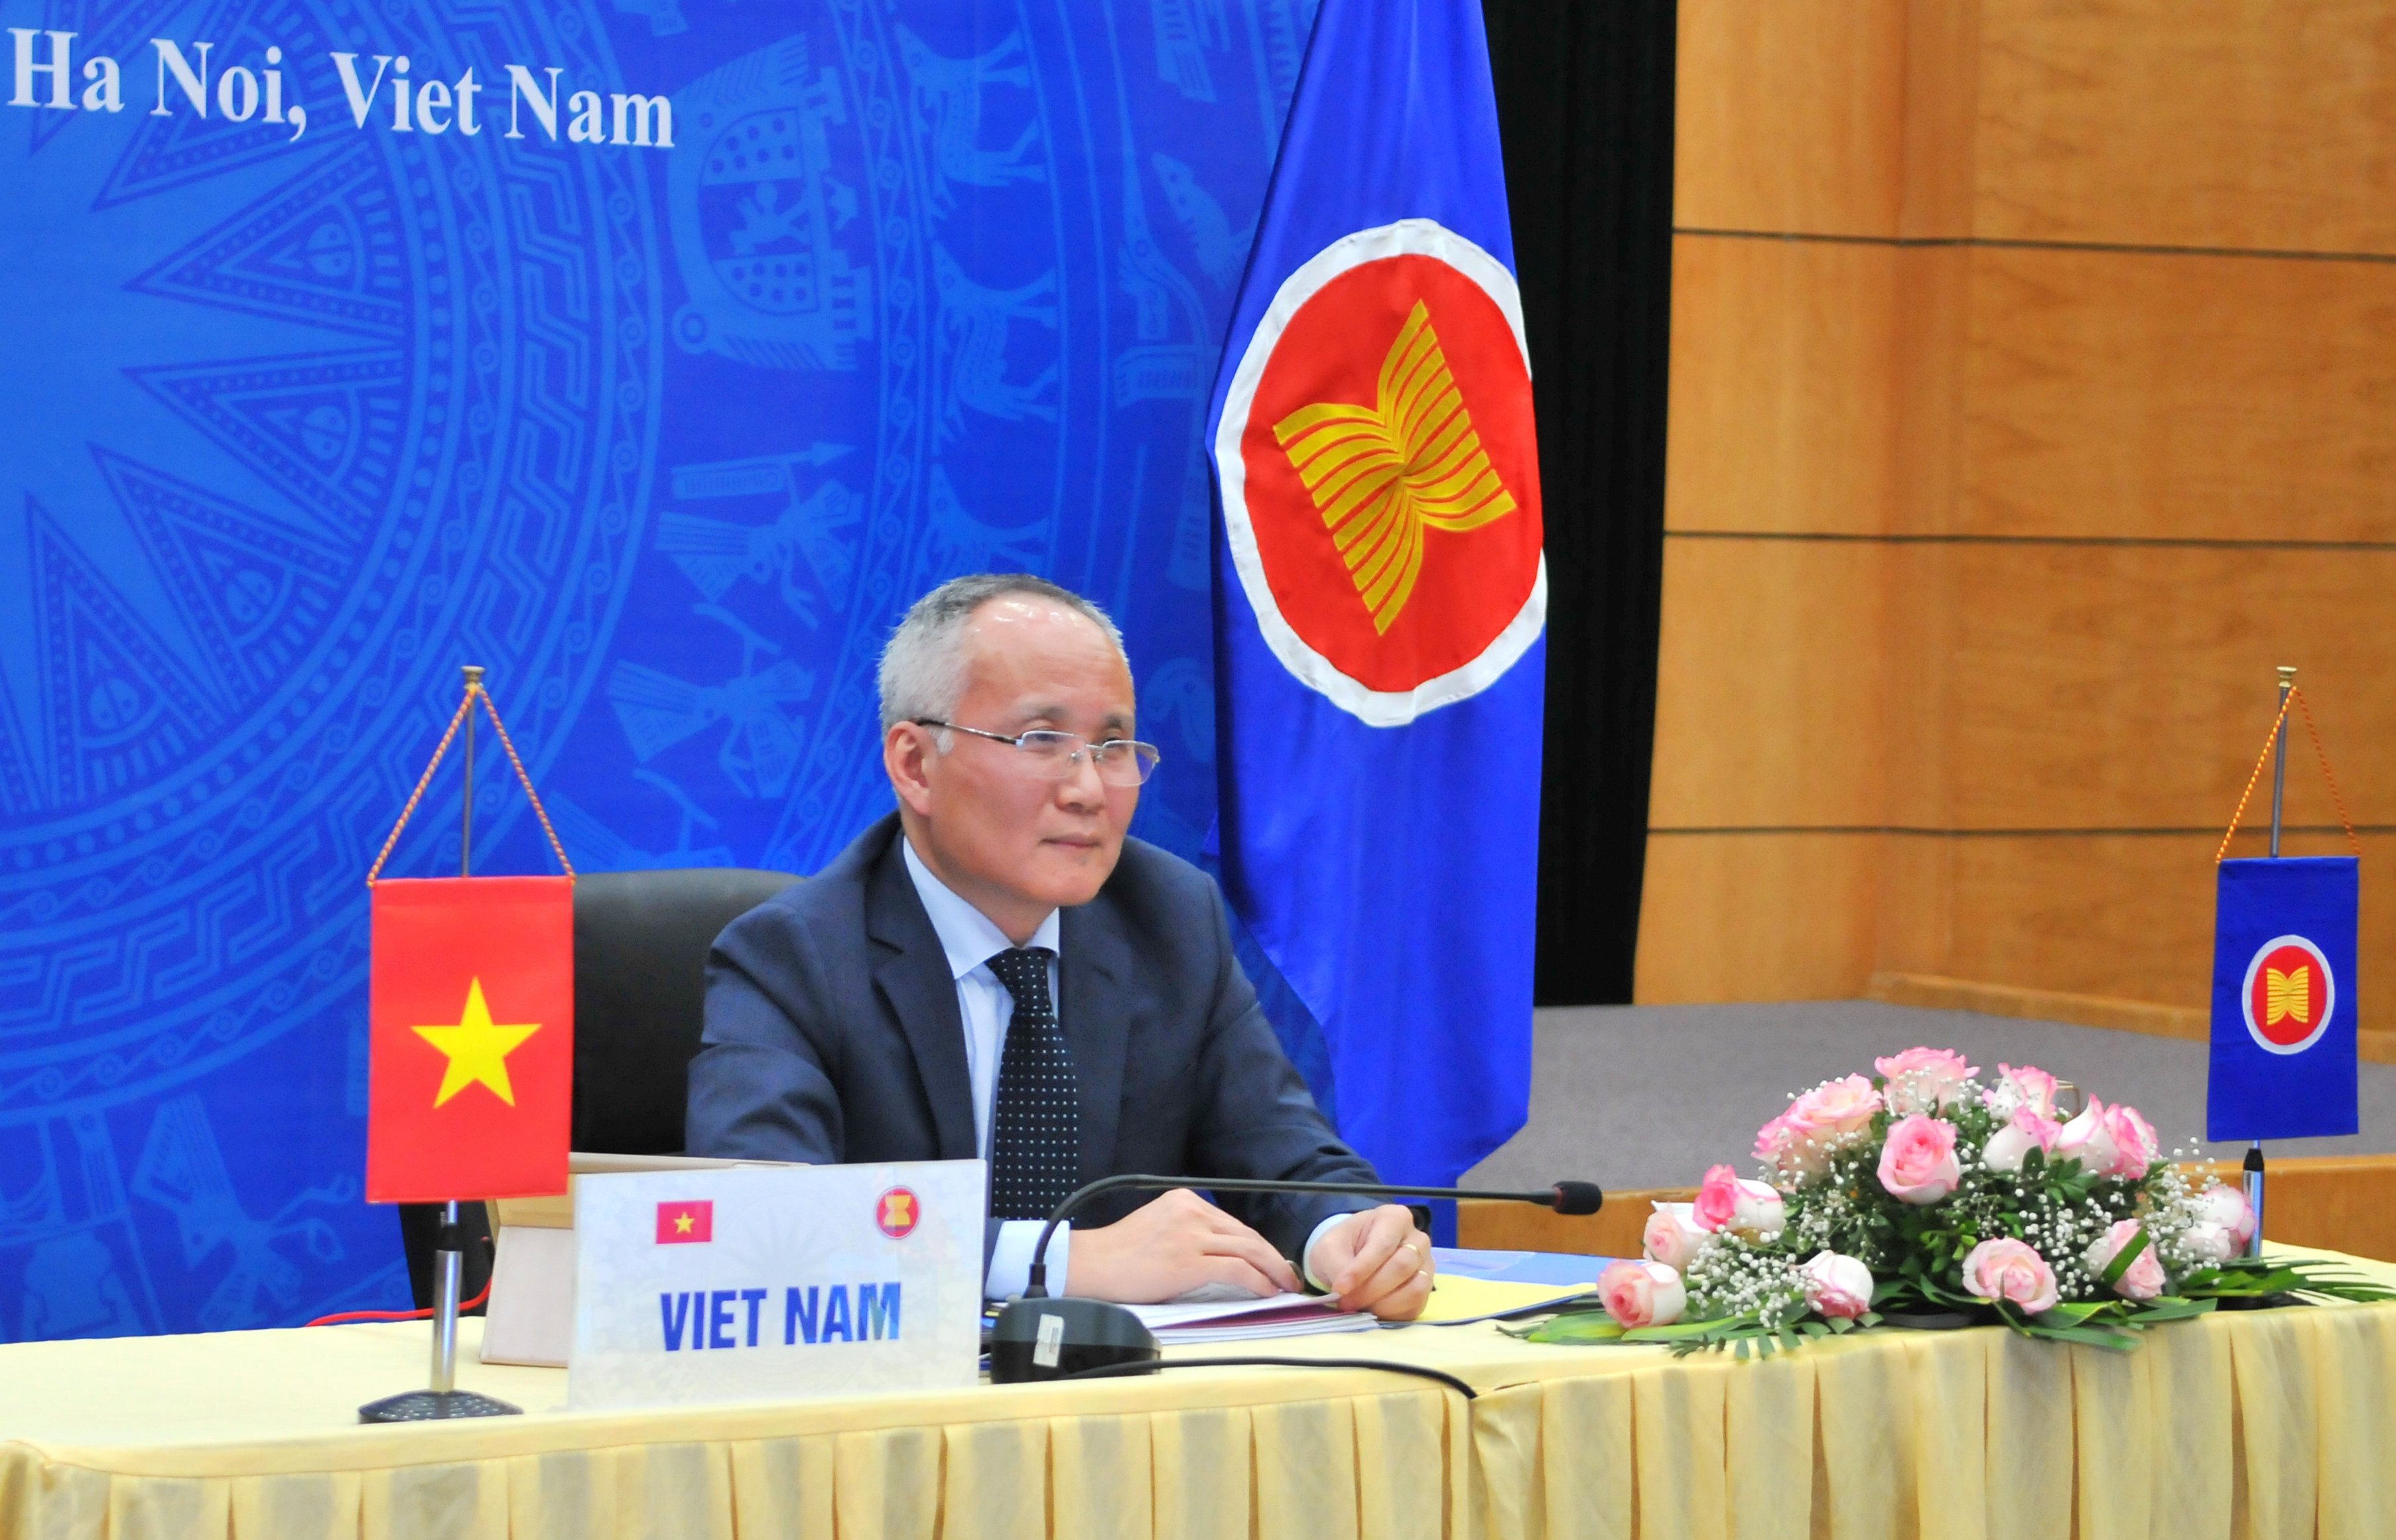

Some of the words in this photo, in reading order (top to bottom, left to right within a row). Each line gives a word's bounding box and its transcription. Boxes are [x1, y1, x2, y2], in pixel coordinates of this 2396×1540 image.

[7, 28, 125, 113] Ha
[150, 38, 307, 142] Noi,
[330, 51, 482, 136] Viet
[504, 64, 675, 148] Nam
[659, 1287, 768, 1352] VIET
[783, 1281, 901, 1346] NAM
